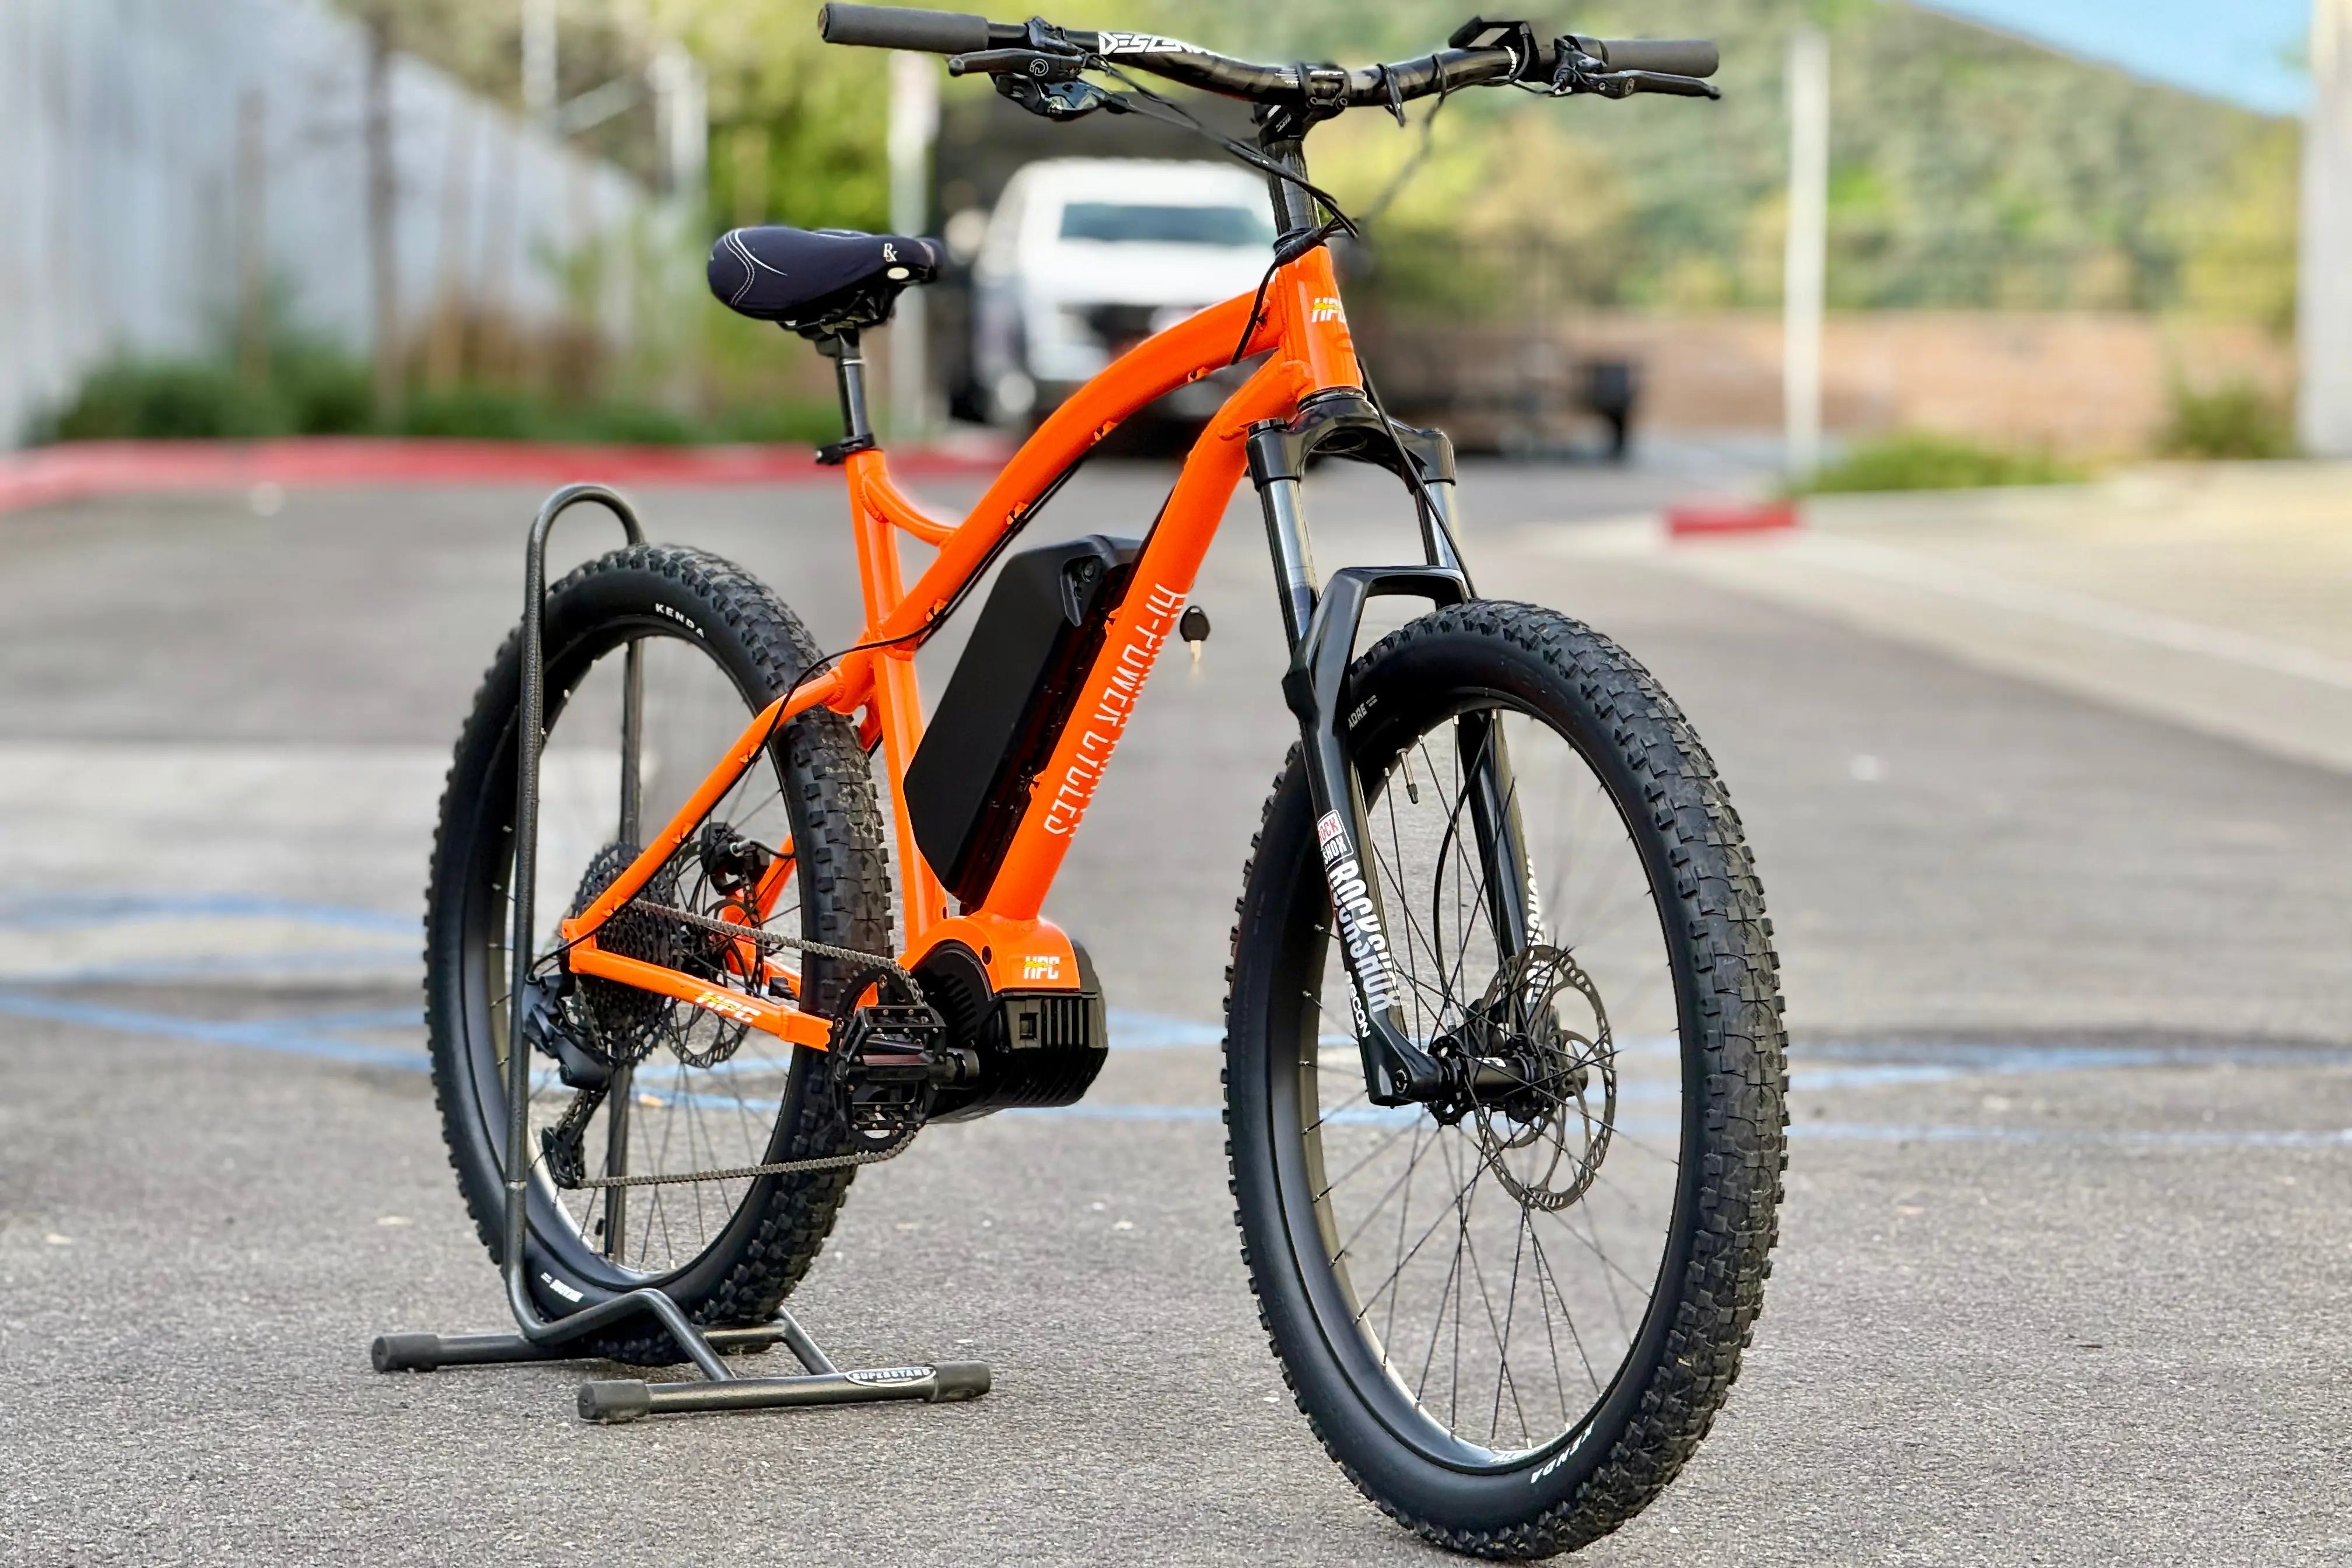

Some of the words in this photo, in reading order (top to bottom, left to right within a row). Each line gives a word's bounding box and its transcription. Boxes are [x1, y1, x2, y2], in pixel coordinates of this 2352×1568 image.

[655, 603, 705, 638] KENDA
[1094, 583, 1188, 728] HI-POWER
[1044, 730, 1119, 838] CYCLES
[1328, 859, 1401, 1013] ROCKSHOX
[1023, 956, 1060, 979] HPC
[695, 991, 761, 1023] HPC
[852, 1368, 931, 1380] SUPERSTAND
[1531, 1420, 1594, 1484] KENDA
